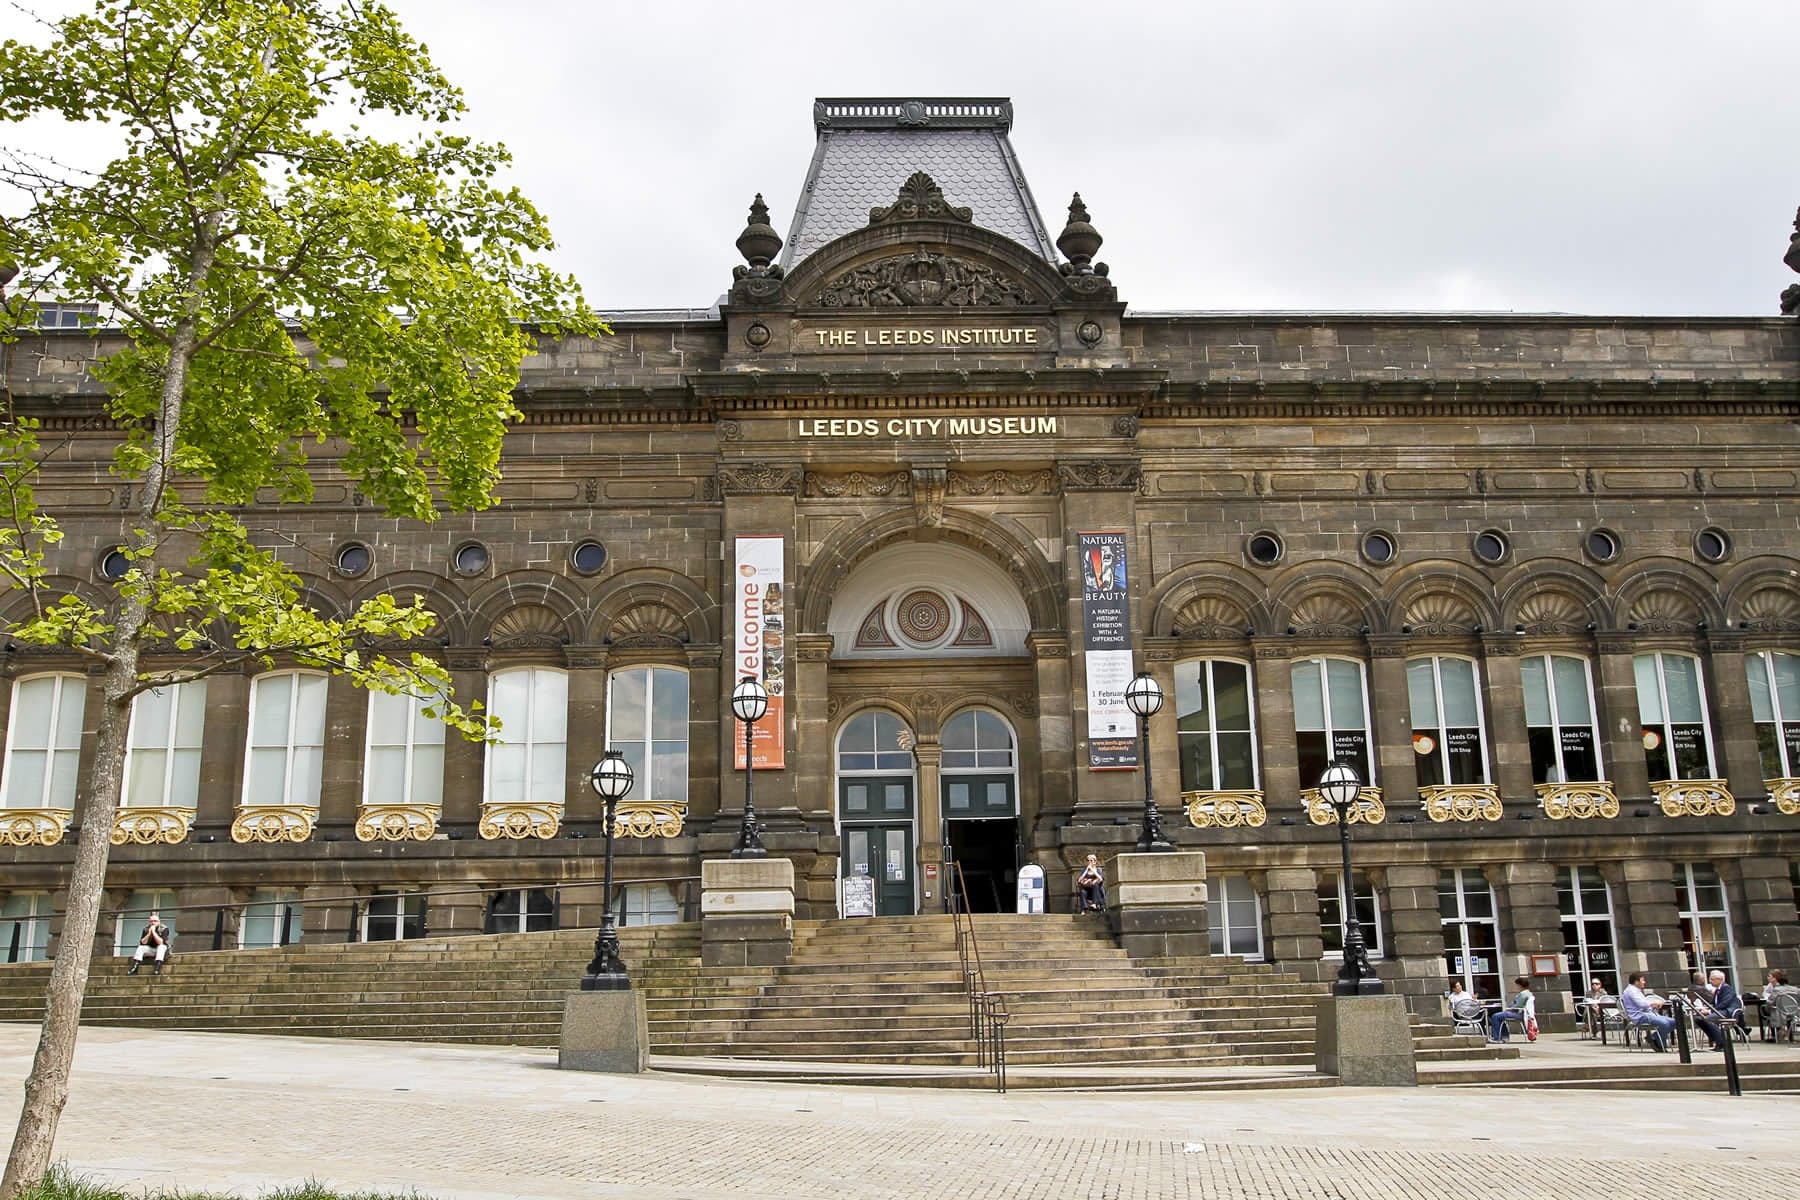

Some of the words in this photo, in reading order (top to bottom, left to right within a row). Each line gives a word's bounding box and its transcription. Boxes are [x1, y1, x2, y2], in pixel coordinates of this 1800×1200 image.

[816, 330, 857, 345] THE
[864, 330, 935, 345] LEEDS
[941, 328, 1037, 344] INSTITUTE
[799, 419, 880, 437] LEEDS
[886, 418, 942, 436] CITY
[949, 417, 1057, 435] MUSEUM
[1082, 536, 1124, 545] NATURAL
[1085, 592, 1127, 601] BEAUTY
[1092, 635, 1125, 643] DIFFERENCE
[1092, 690, 1096, 698] 1
[1098, 690, 1126, 699] February
[1097, 698, 1108, 706] 30
[1352, 736, 1364, 744] City
[1592, 951, 1608, 960] Café
